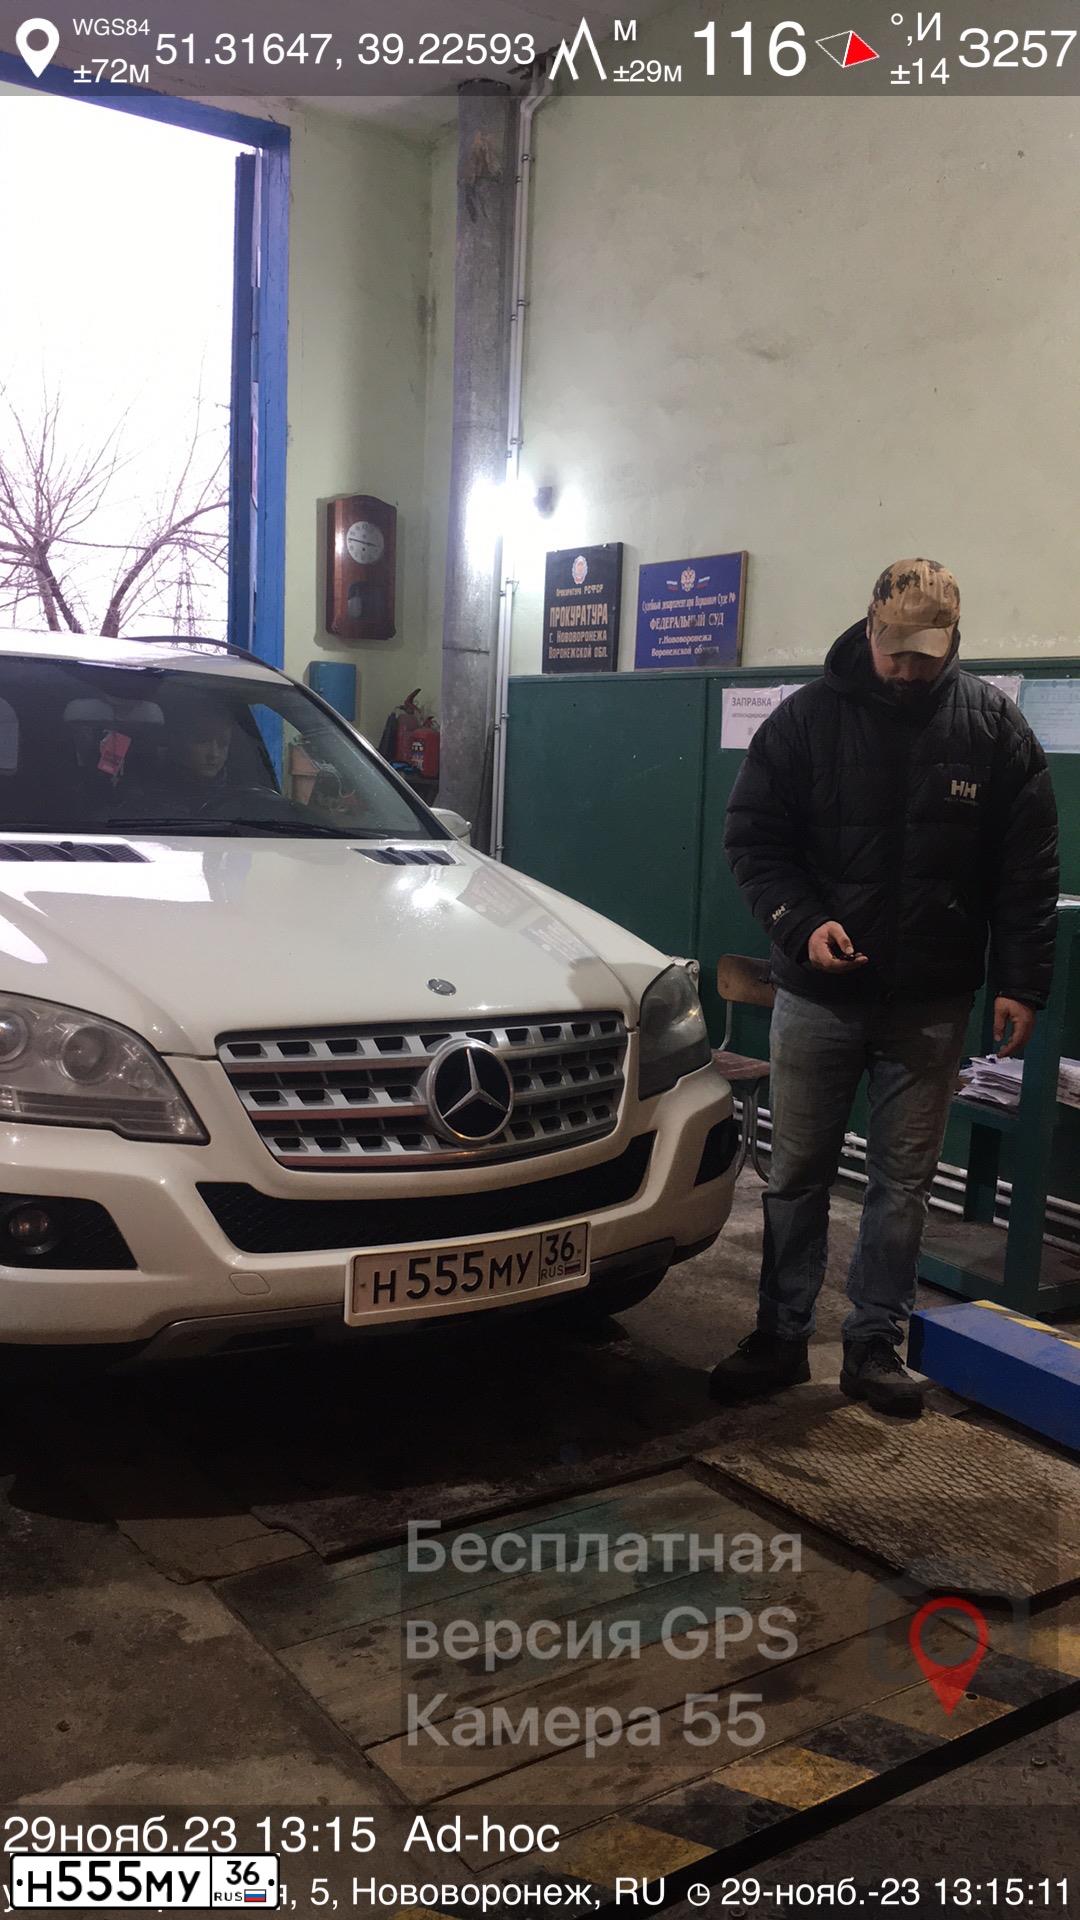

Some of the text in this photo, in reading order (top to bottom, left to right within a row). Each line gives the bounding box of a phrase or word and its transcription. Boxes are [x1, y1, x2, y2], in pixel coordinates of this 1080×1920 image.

[549, 603, 608, 628] ПРОКУРАТУРА
[708, 612, 724, 627] СУД
[731, 696, 772, 707] ЗАПРАВКА
[951, 779, 978, 799] HH
[540, 1266, 564, 1280] RUS
